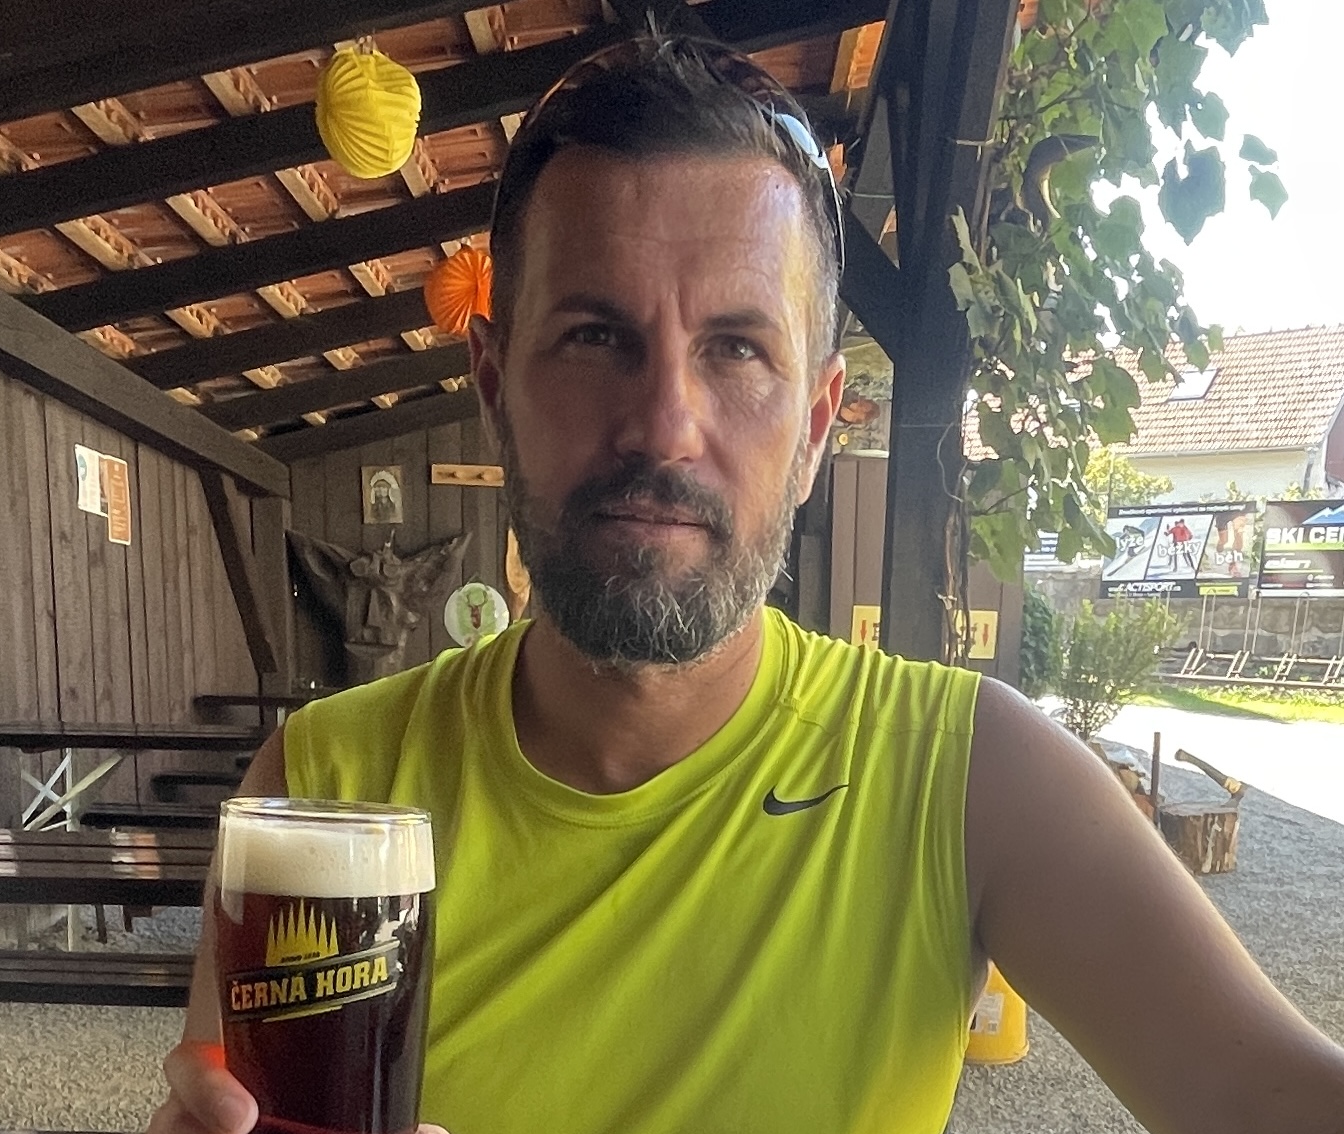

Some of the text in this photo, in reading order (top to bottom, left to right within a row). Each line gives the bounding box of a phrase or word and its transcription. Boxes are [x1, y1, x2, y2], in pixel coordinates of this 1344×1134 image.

[1116, 534, 1144, 551] lyže
[1265, 527, 1305, 545] SKI
[1157, 541, 1201, 558] běžky
[1215, 551, 1244, 565] běh
[231, 956, 389, 1011] ČERNÁ HORA
